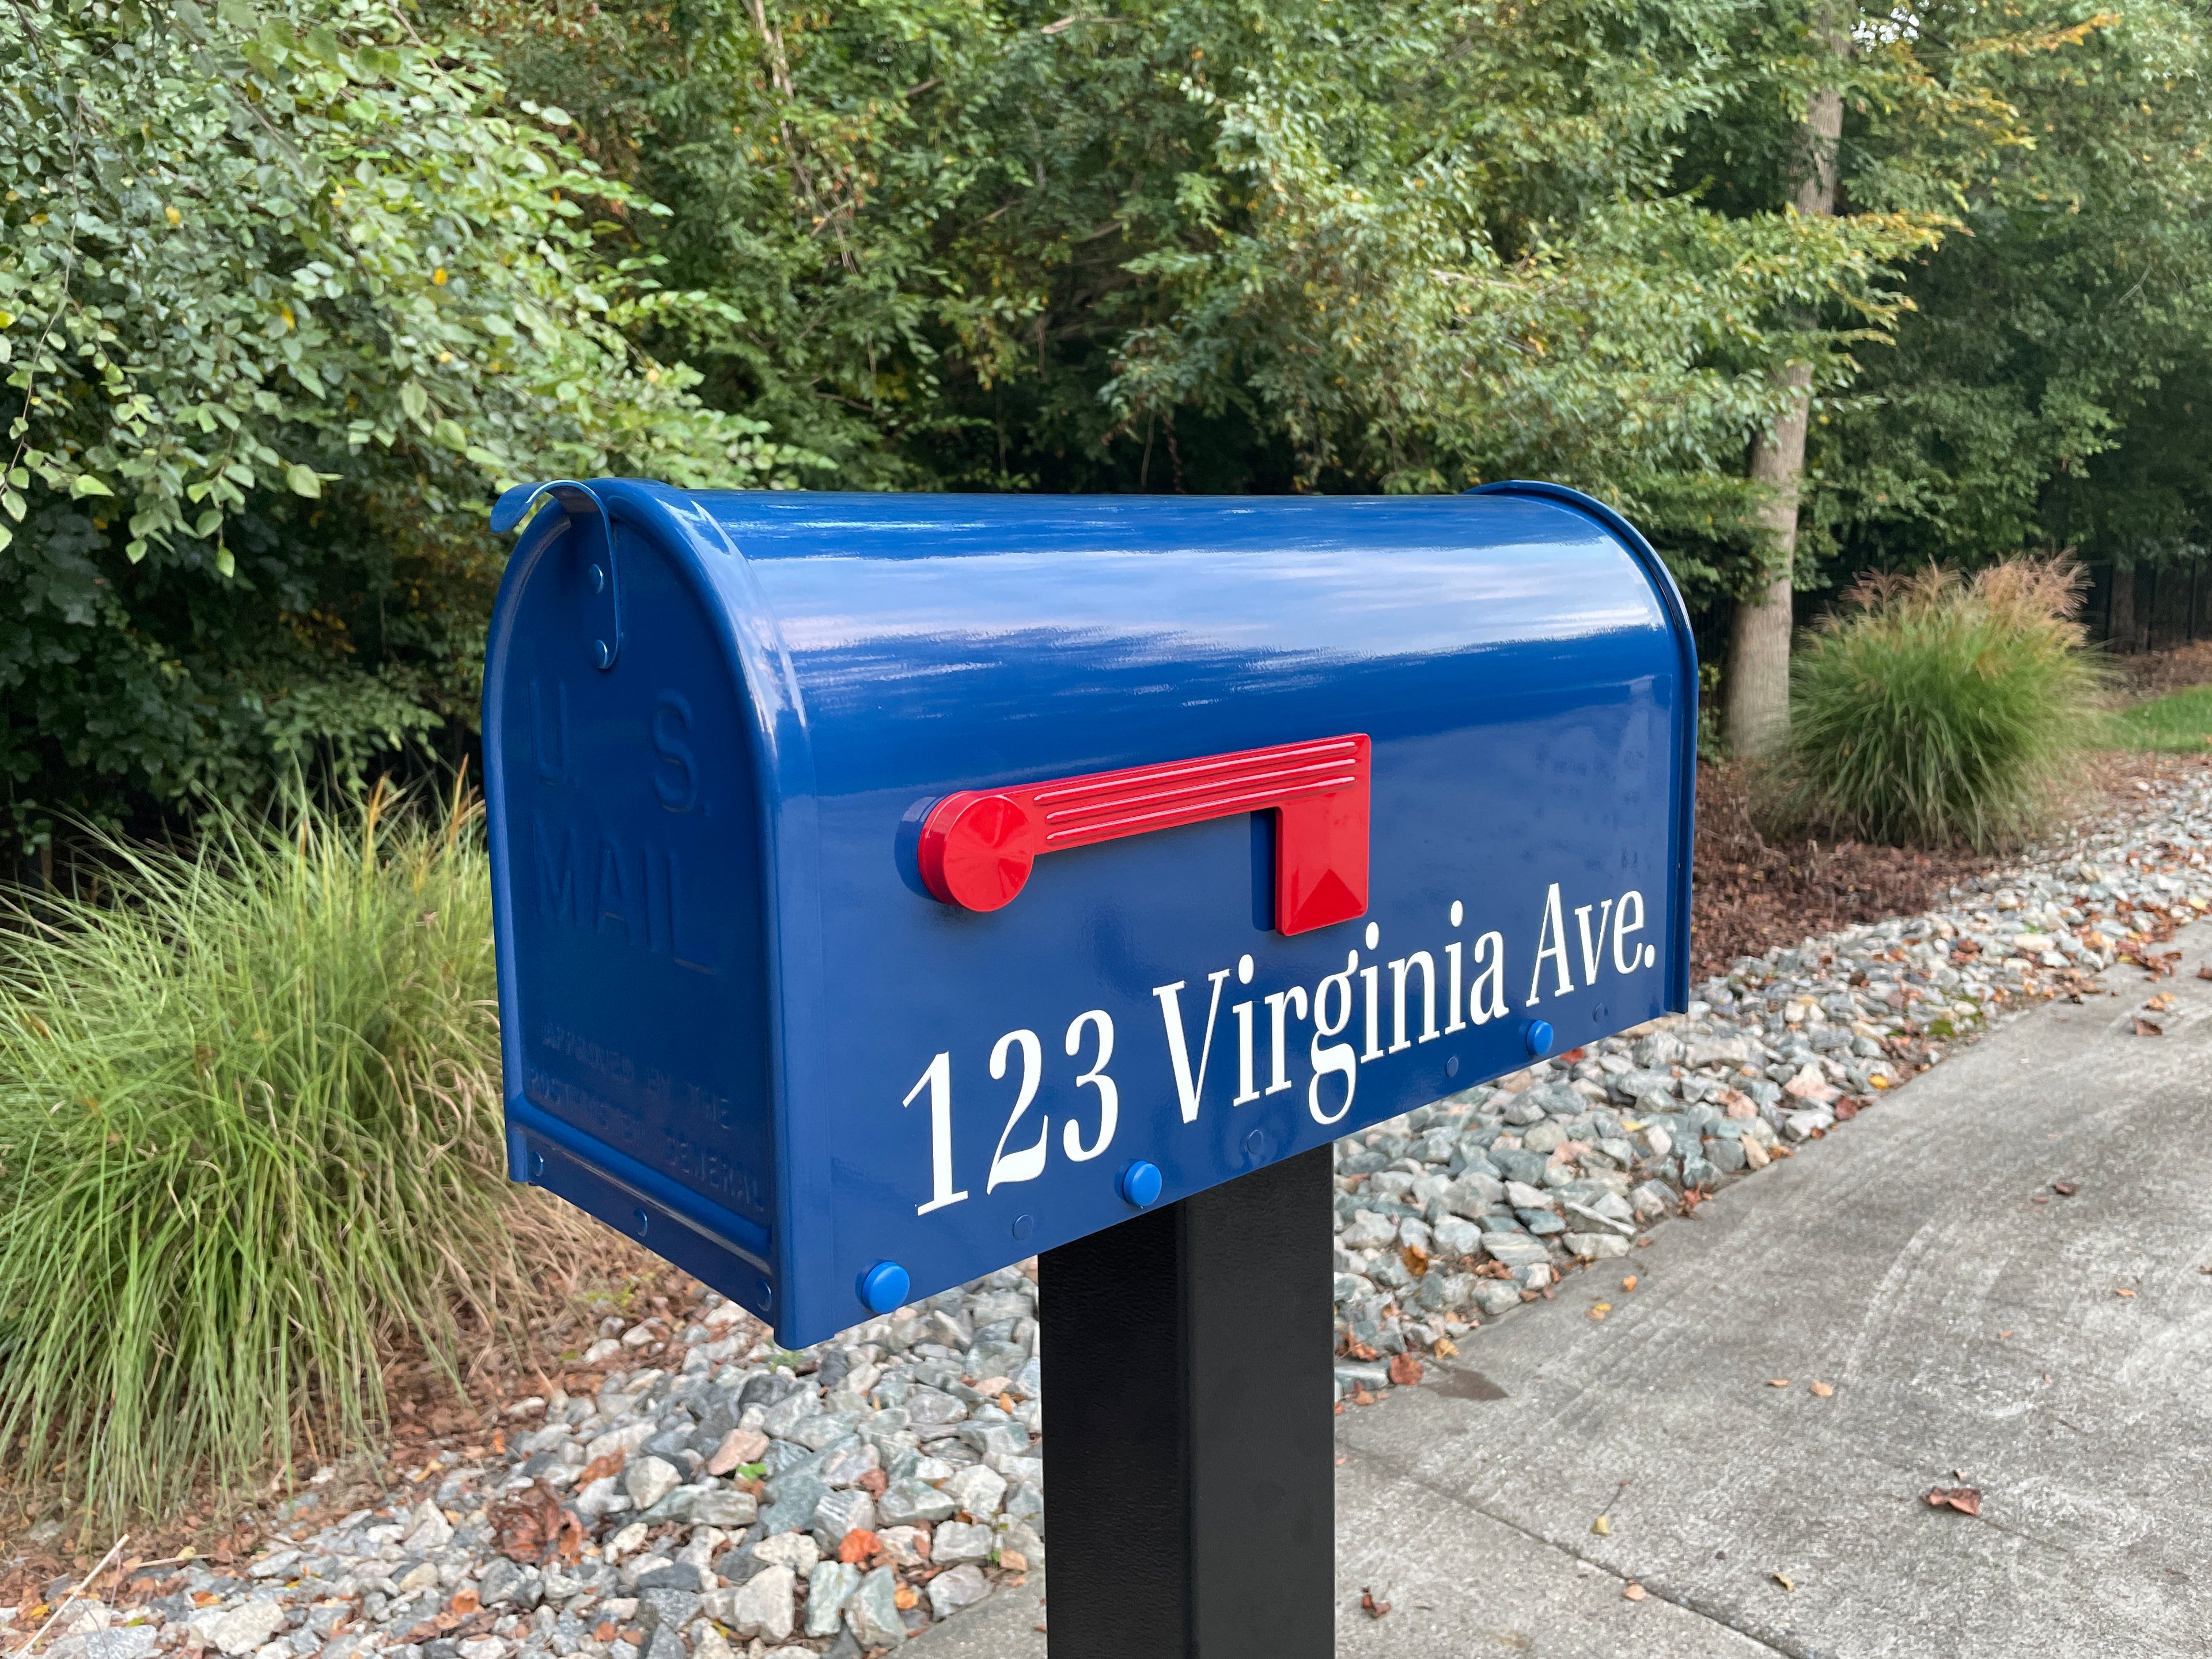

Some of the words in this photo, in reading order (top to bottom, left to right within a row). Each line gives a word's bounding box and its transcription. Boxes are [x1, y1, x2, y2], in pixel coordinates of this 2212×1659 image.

[531, 808, 719, 976] MAIL
[902, 1009, 1119, 1217] 123
[1152, 899, 1510, 1126] Virginia
[1525, 882, 1656, 1007] Ave.
